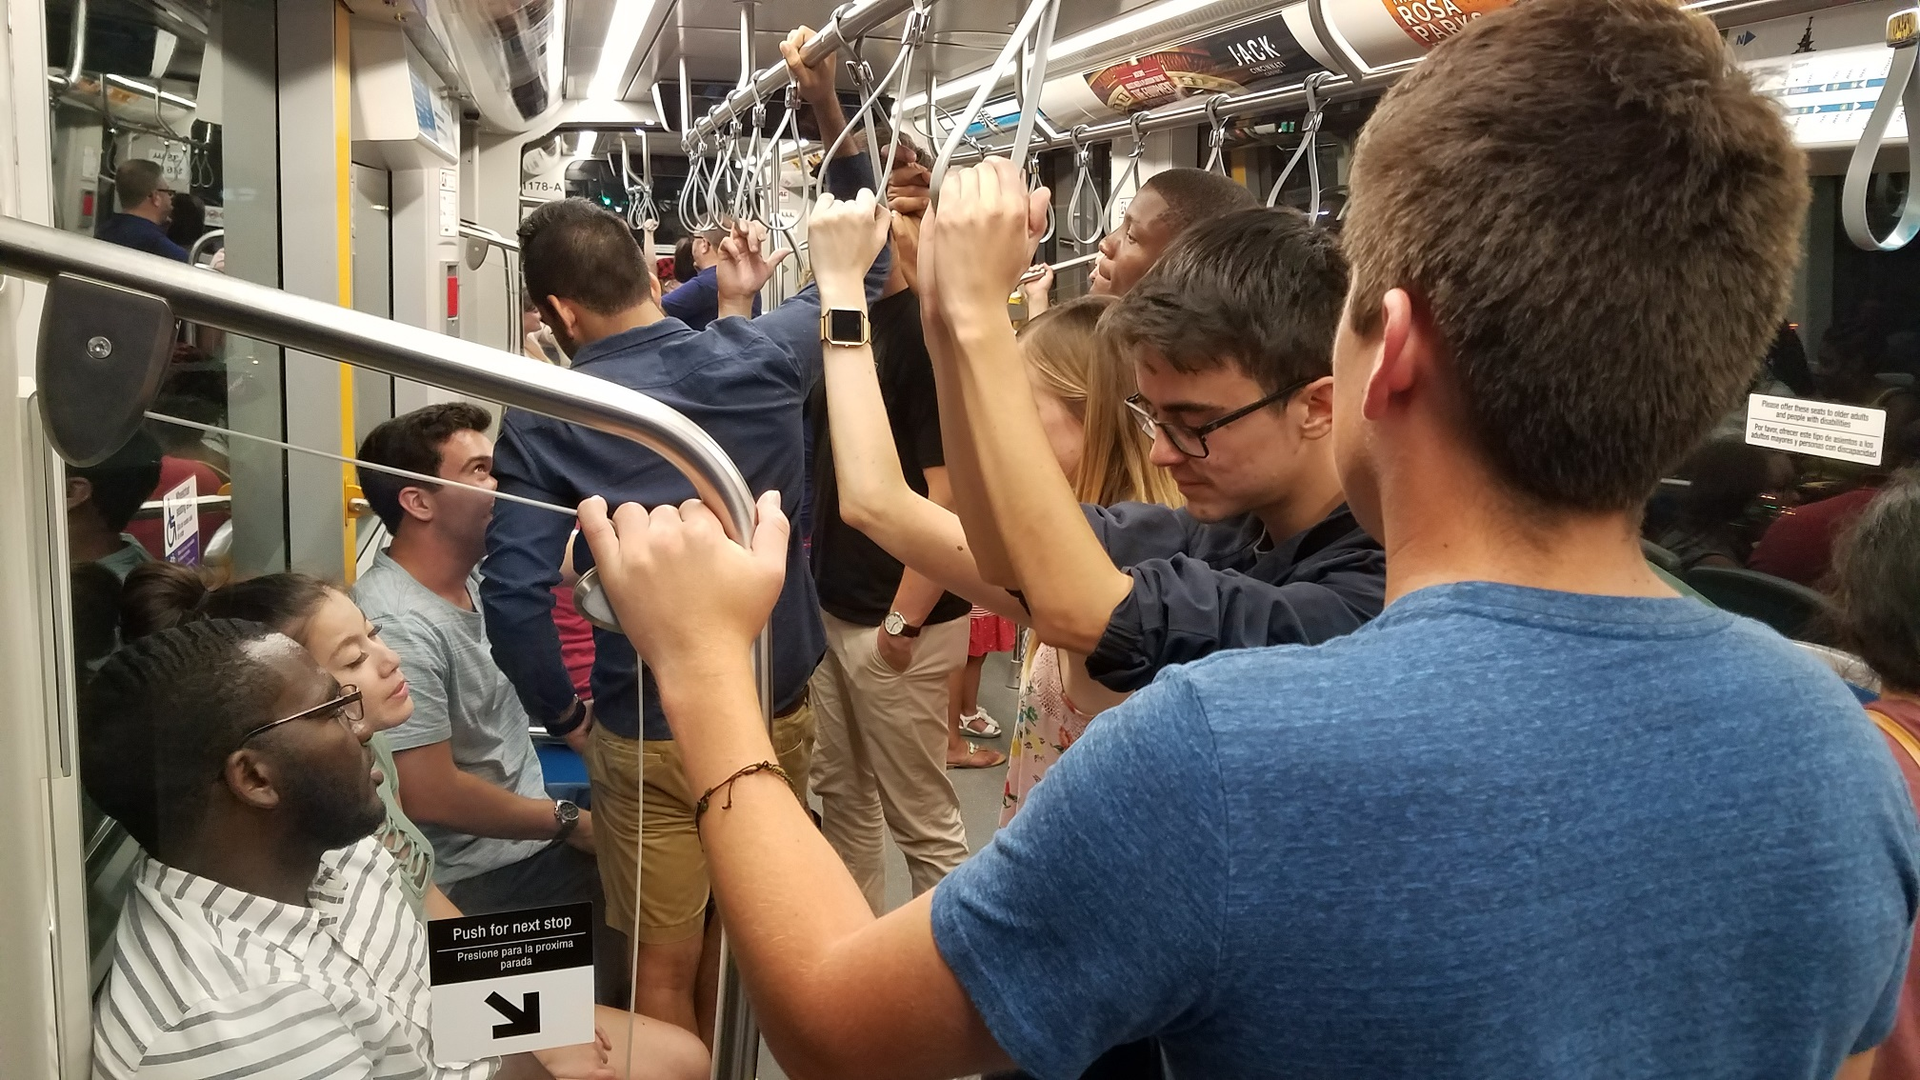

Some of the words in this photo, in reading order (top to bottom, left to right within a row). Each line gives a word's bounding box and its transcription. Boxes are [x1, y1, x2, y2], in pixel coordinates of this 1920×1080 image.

[1396, 0, 1462, 26] ROSA
[1249, 61, 1287, 74] CINCINNATI
[522, 181, 563, 192] 1178-A
[1761, 399, 1780, 410] Please
[1780, 403, 1794, 411] offer
[1794, 404, 1810, 413] these
[1811, 407, 1826, 416] seats
[1827, 409, 1834, 417] to
[1834, 410, 1850, 419] older
[1850, 412, 1869, 421] adults
[1776, 411, 1787, 419] and
[1787, 413, 1806, 422] people
[1807, 415, 1819, 423] with
[1820, 417, 1851, 428] disabilities
[1751, 431, 1770, 441] adultos
[1771, 435, 1793, 444] mayores
[1799, 440, 1824, 450] personas
[1837, 444, 1877, 458] discapacidad
[1755, 423, 1764, 431] Por
[1779, 427, 1799, 437] ofrecer
[1800, 431, 1812, 439] este
[1813, 432, 1824, 441] tipo
[1825, 434, 1832, 442] de
[1833, 436, 1858, 446] asientos
[1864, 440, 1874, 449] los
[453, 925, 486, 941] Push
[490, 923, 509, 936] for
[513, 918, 540, 934] next
[544, 916, 572, 930] stop
[457, 949, 499, 962] Presione
[501, 946, 522, 959] para
[524, 943, 533, 953] la
[535, 939, 574, 954] proxima
[500, 956, 533, 971] parada
